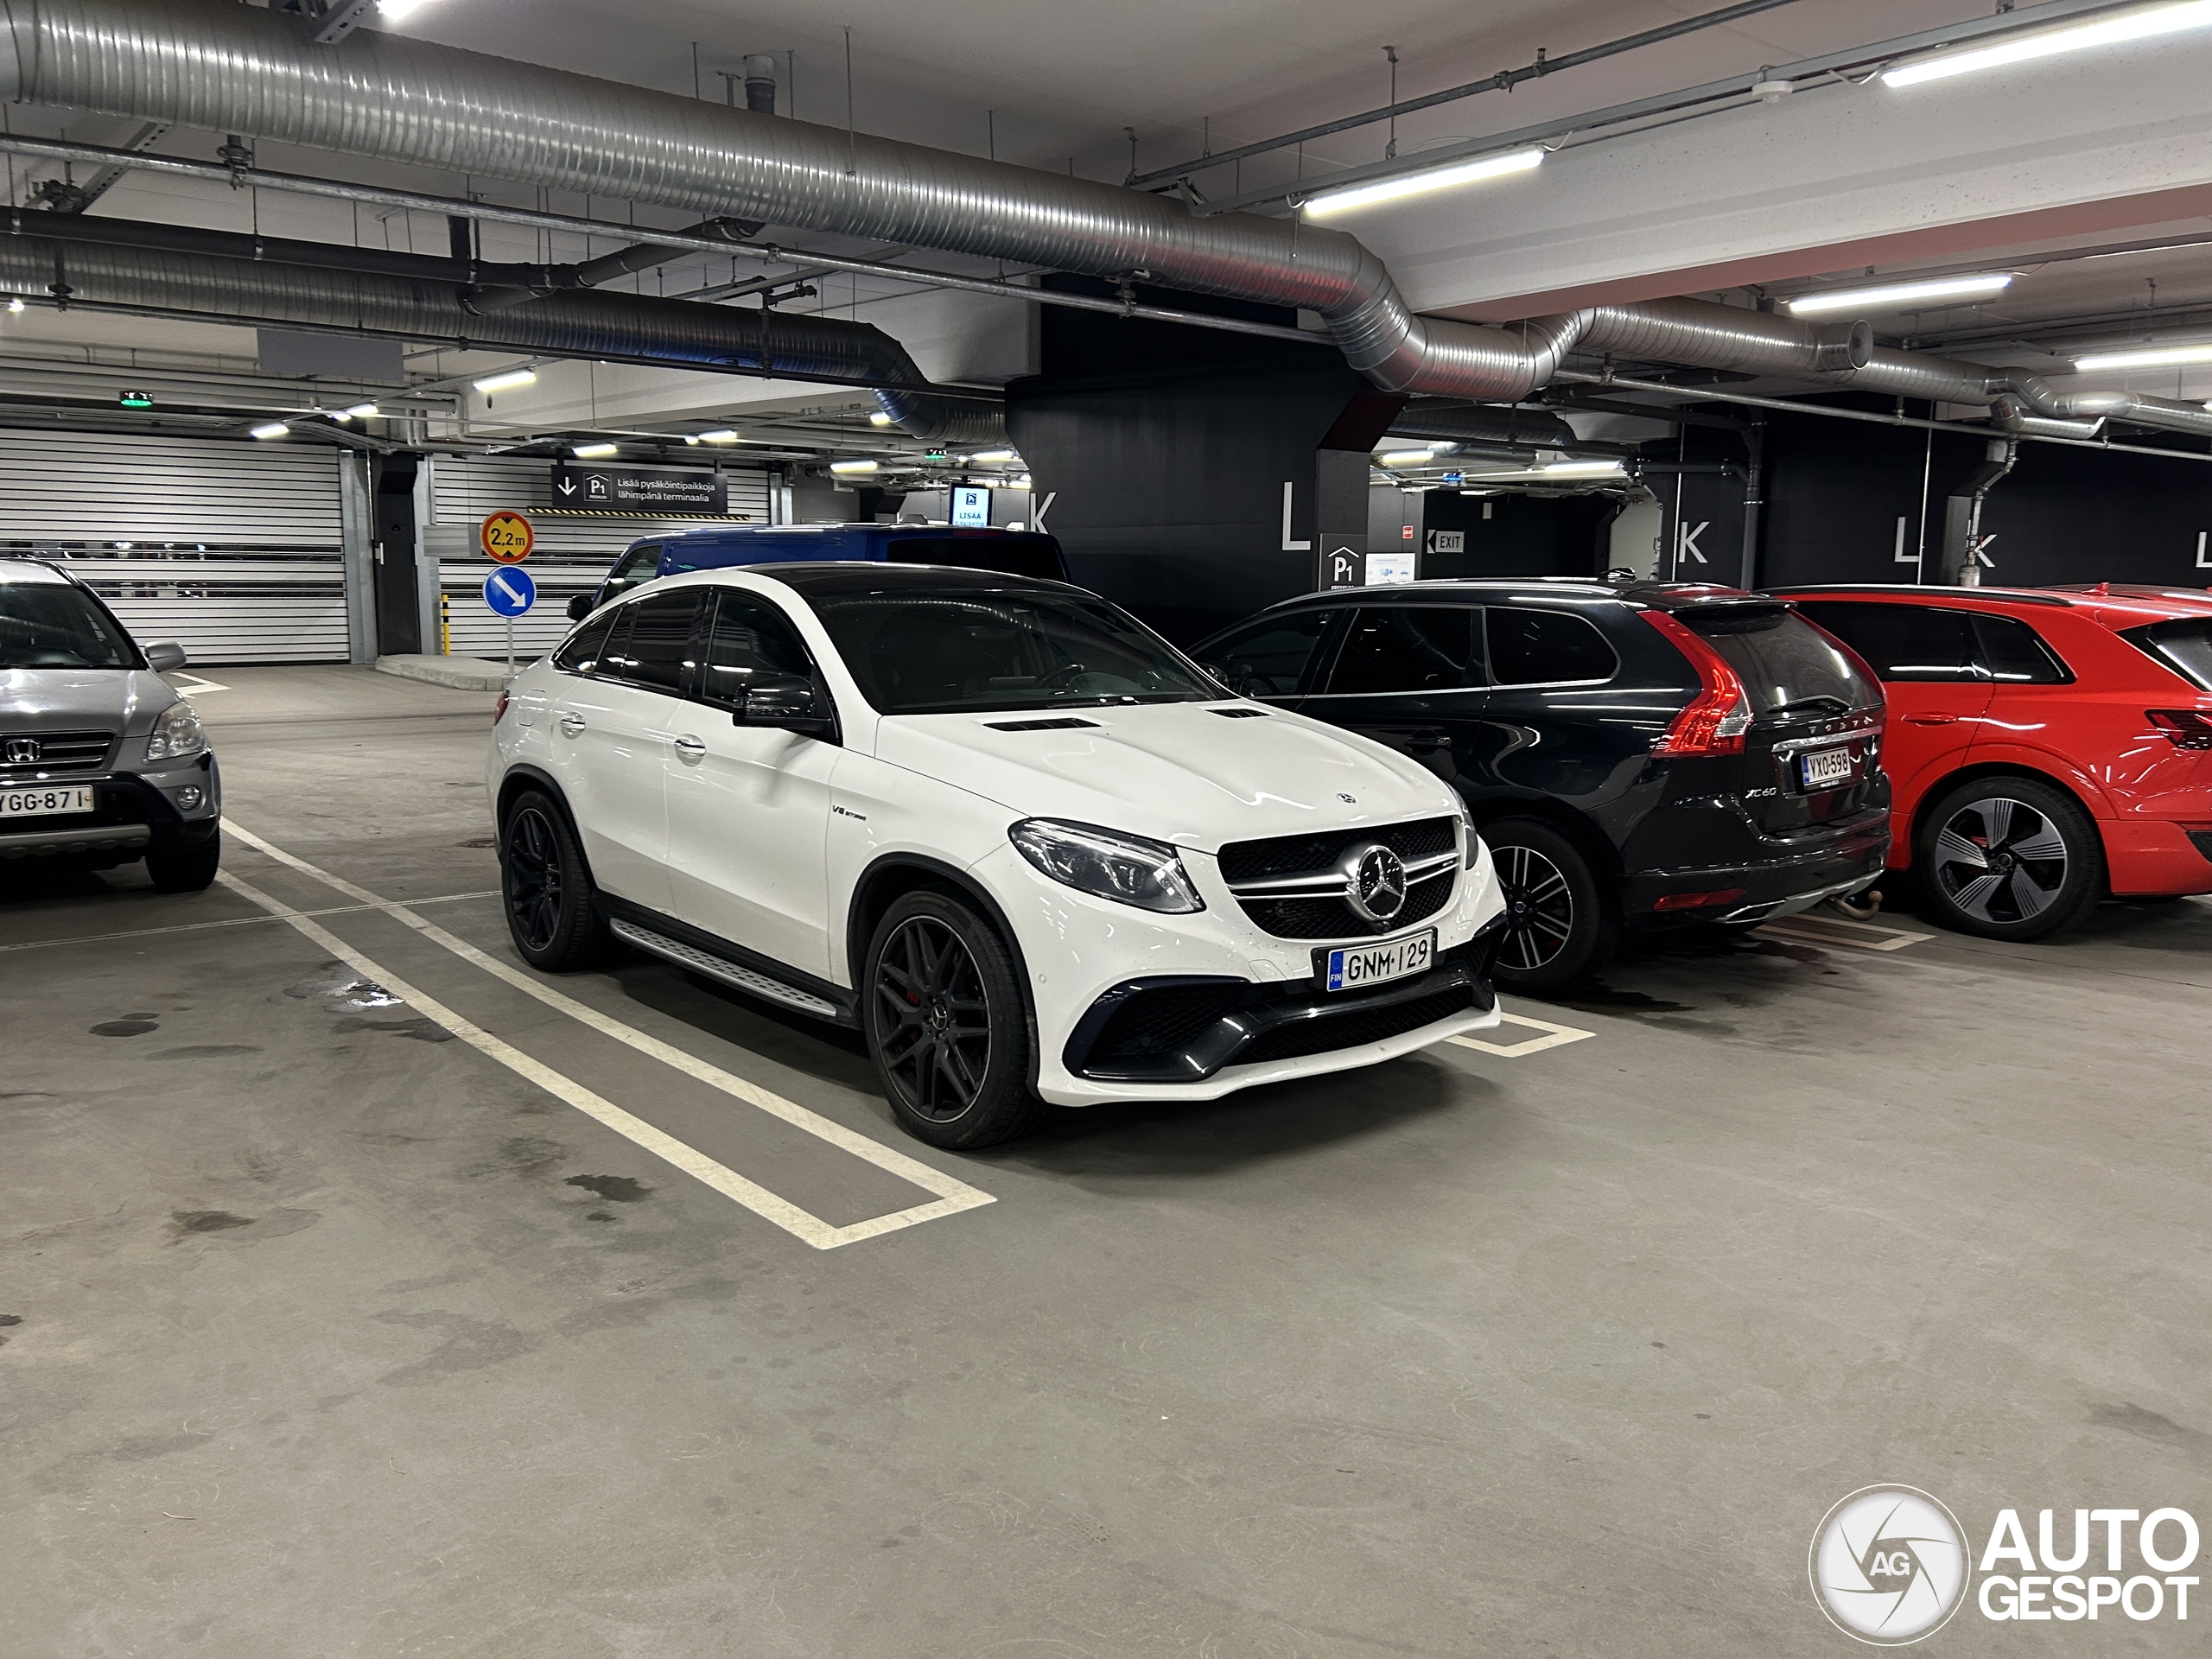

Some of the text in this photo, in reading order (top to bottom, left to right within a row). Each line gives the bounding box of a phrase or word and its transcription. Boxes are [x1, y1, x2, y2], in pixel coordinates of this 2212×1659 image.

[617, 479, 715, 493] Lisää pysäköintipaikkoja
[618, 490, 709, 502] lähimpänä terminaalia
[1030, 492, 1057, 535] K
[1281, 481, 1312, 550] L
[491, 528, 525, 547] 2,2 m
[1440, 536, 1460, 549] EXIT
[1679, 521, 1710, 563] K
[1894, 517, 1920, 563] L
[1809, 753, 1848, 778] VXO-598
[1745, 787, 1777, 798] XC60
[1348, 939, 1428, 980] GNM-129
[1330, 973, 1342, 982] FIN
